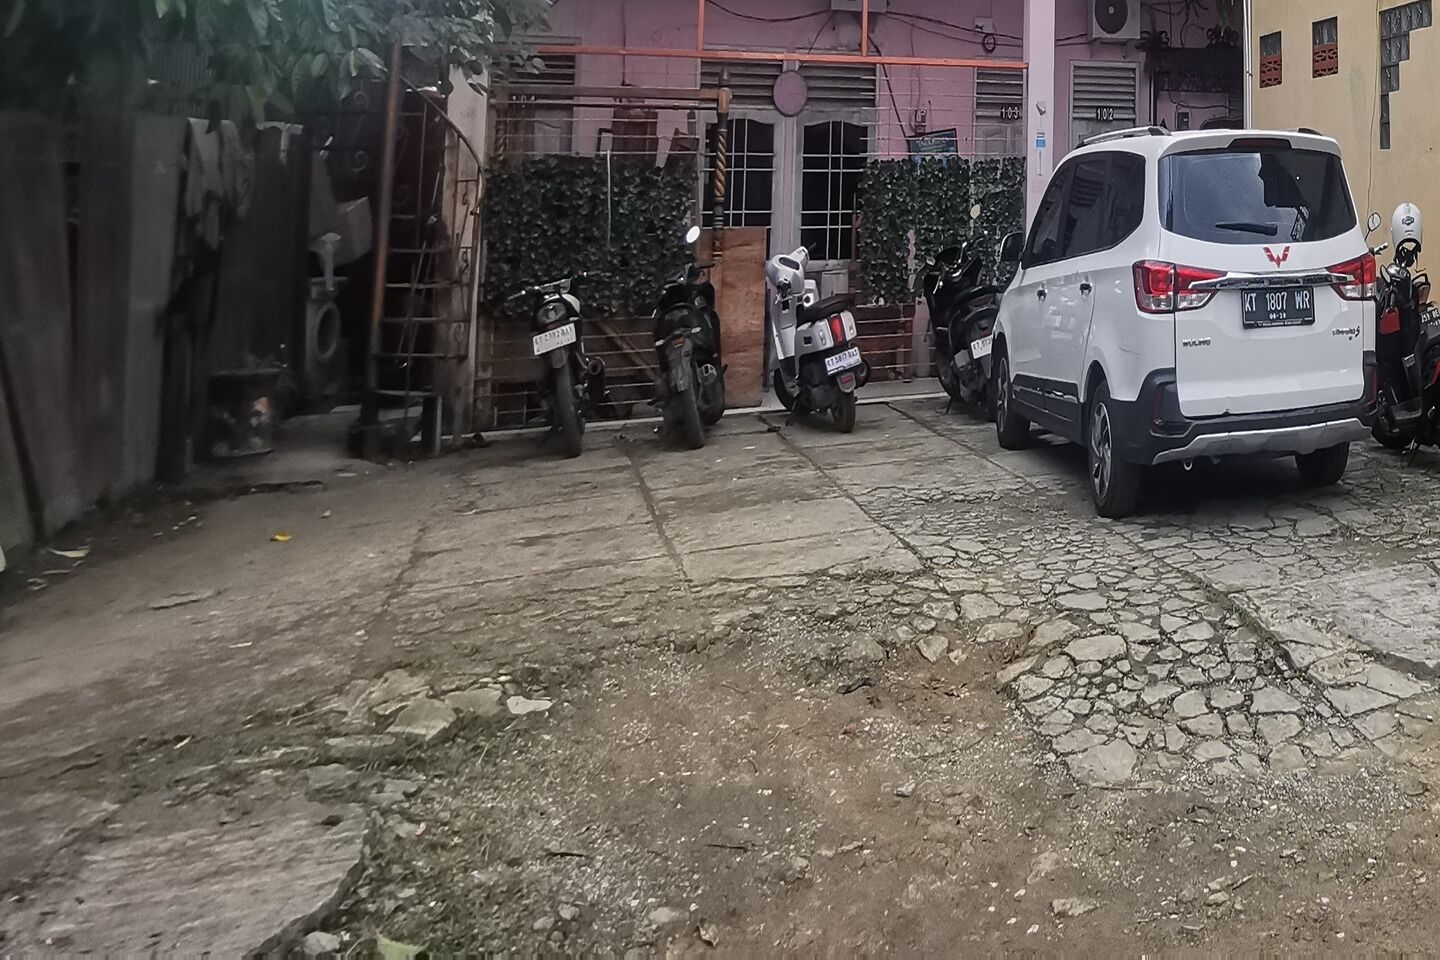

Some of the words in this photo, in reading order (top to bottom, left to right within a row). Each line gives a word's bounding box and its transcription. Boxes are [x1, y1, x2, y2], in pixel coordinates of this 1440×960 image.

[1000, 106, 1019, 120] 103
[1096, 107, 1114, 121] 102
[1244, 293, 1256, 312] KT
[1265, 292, 1287, 311] 1807
[1295, 290, 1310, 309] WR
